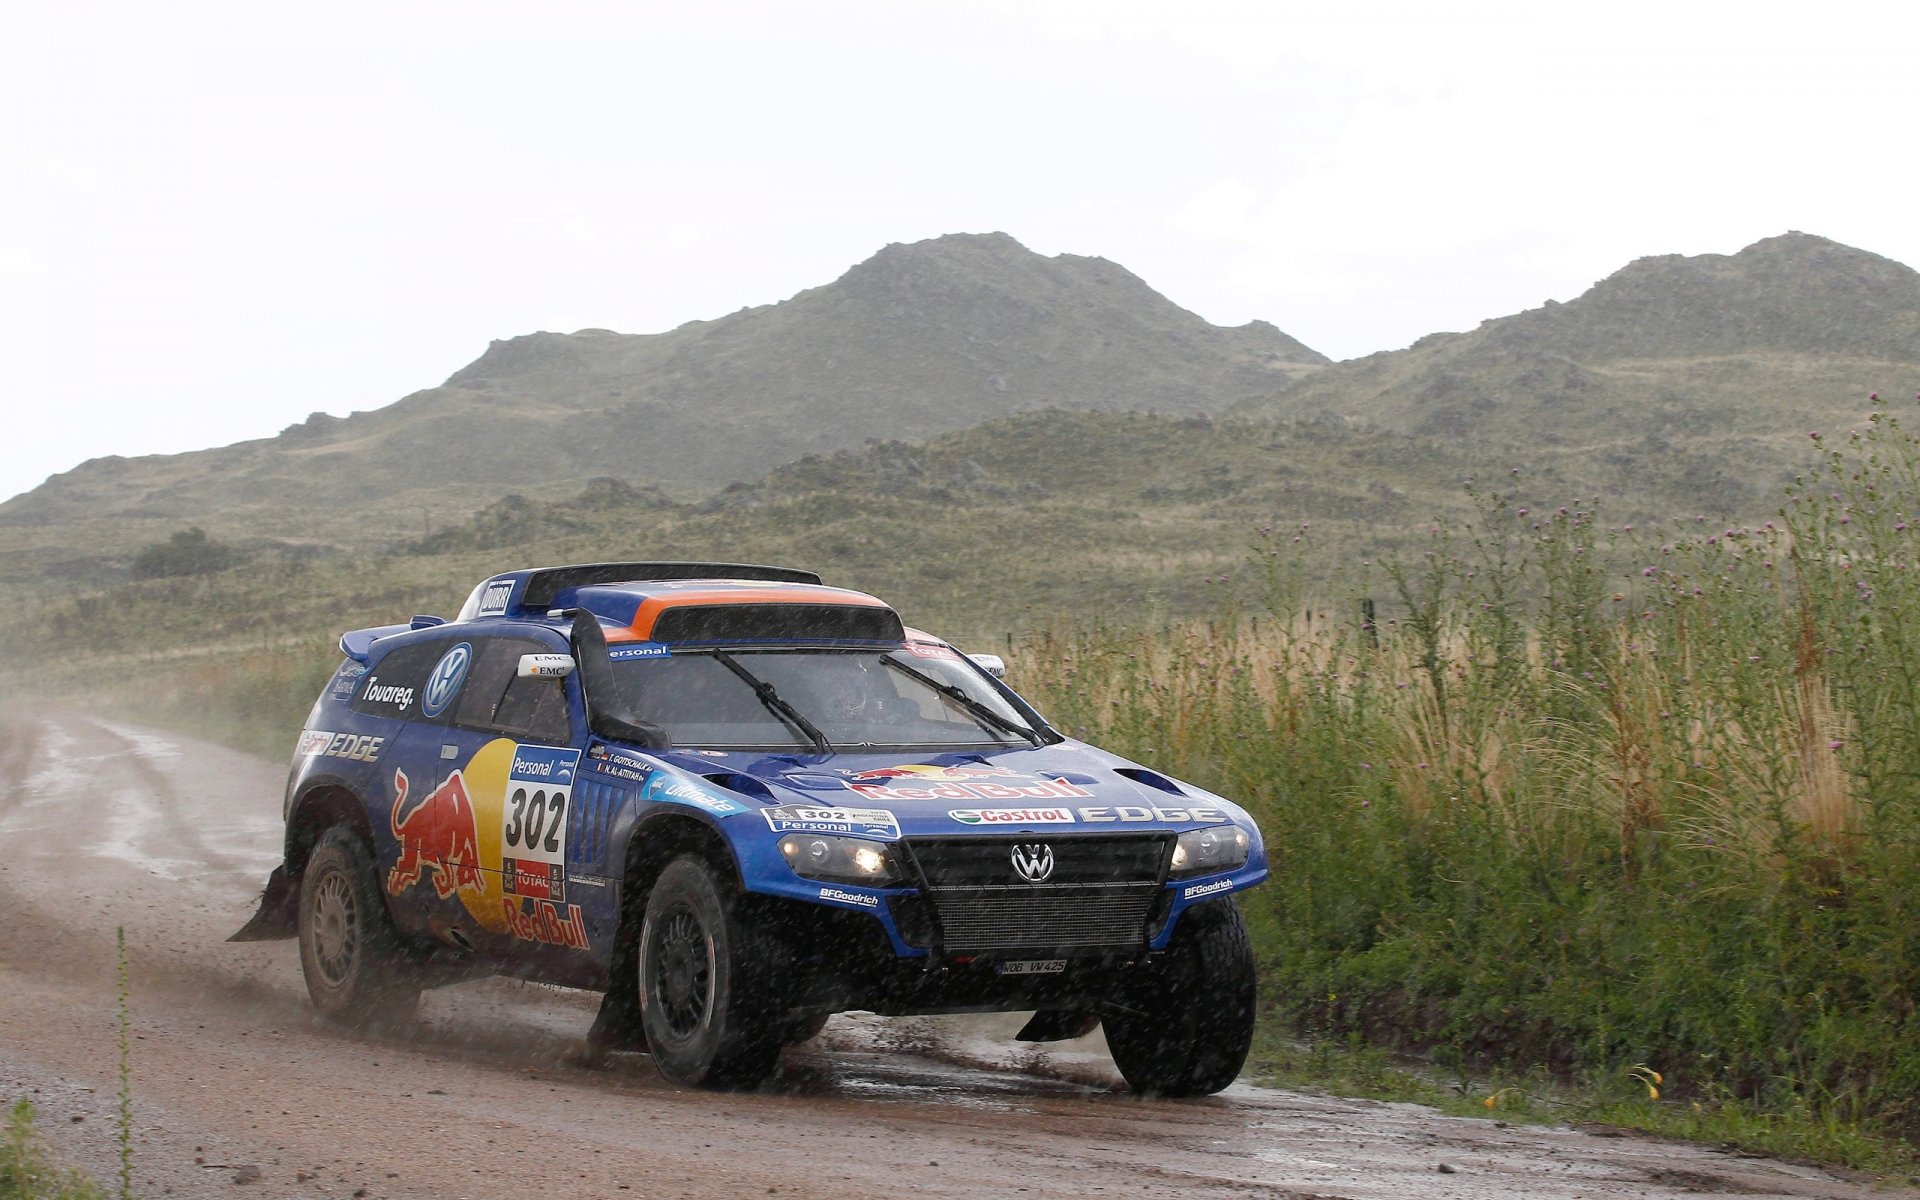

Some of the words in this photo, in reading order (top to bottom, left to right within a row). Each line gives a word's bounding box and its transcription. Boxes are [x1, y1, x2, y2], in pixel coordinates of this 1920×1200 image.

[609, 645, 667, 658] ersonal
[324, 733, 385, 763] EDGE
[512, 757, 554, 776] Personal
[665, 782, 736, 812] ultimate
[505, 788, 566, 853] 302
[804, 811, 847, 820] 302
[980, 808, 1068, 822] Castrol
[1077, 806, 1226, 823] EDGE
[782, 821, 852, 832] Personal
[516, 868, 549, 888] TOTAL
[820, 888, 878, 905] BFGoodrich
[1184, 879, 1233, 897] BFGoodrich
[1003, 962, 1024, 973] WOB
[1030, 961, 1045, 972] VW
[1044, 961, 1065, 971] 425
